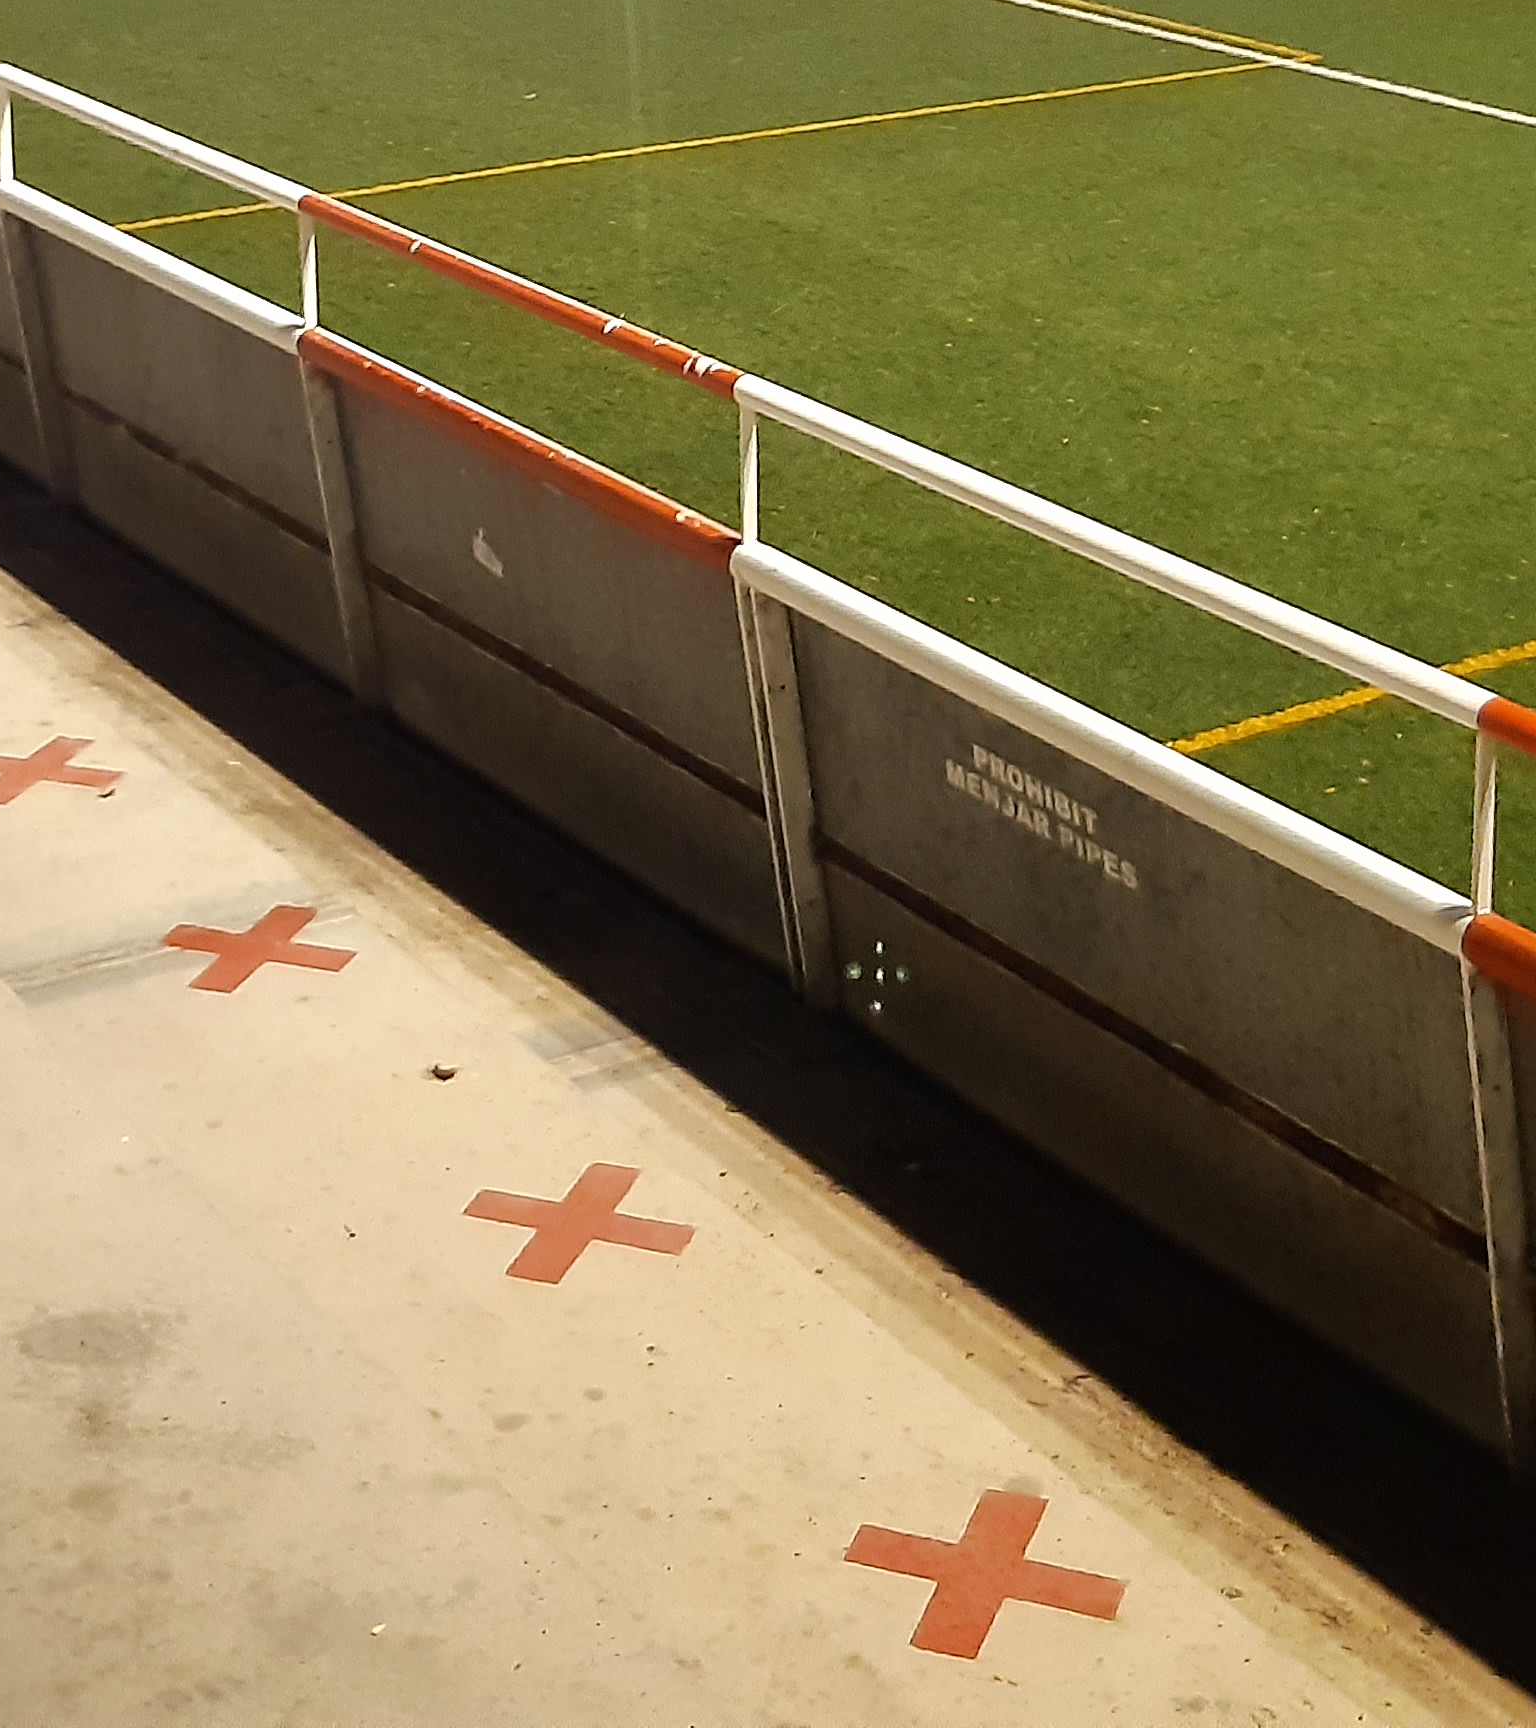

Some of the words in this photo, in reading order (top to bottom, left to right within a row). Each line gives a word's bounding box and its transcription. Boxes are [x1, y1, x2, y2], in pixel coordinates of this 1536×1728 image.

[945, 757, 1052, 840] MENJAR
[1057, 824, 1138, 889] PIPES
[972, 743, 1098, 835] PROHIBIT
